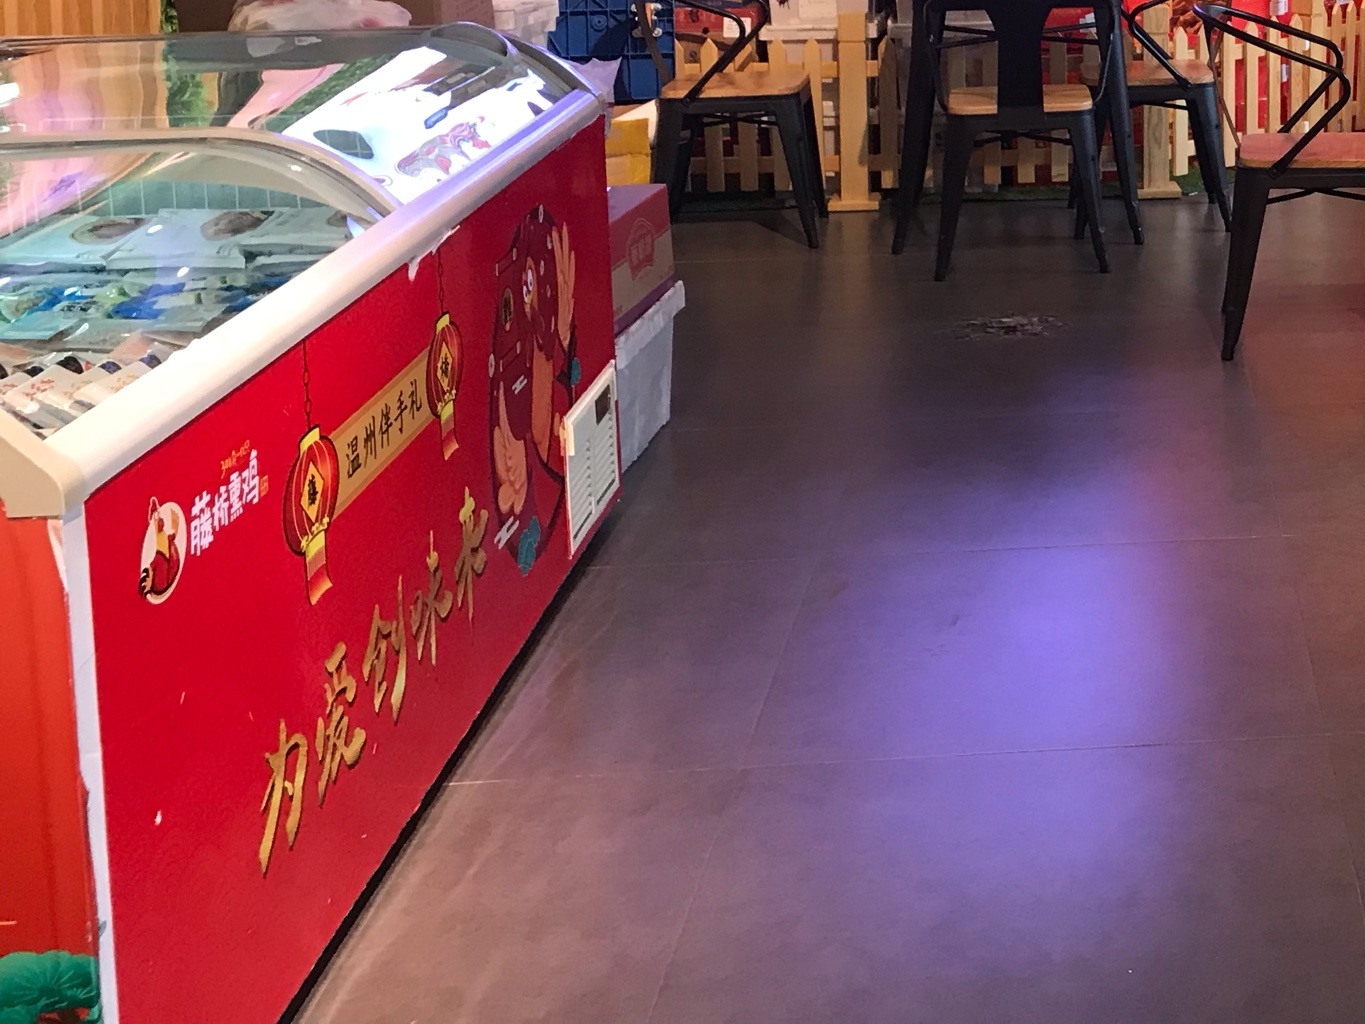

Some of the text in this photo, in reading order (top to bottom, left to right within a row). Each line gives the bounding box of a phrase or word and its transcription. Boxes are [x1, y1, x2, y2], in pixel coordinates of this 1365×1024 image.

[346, 378, 423, 479] 温州伴手礼
[190, 448, 260, 556] 藤桥熏鸡
